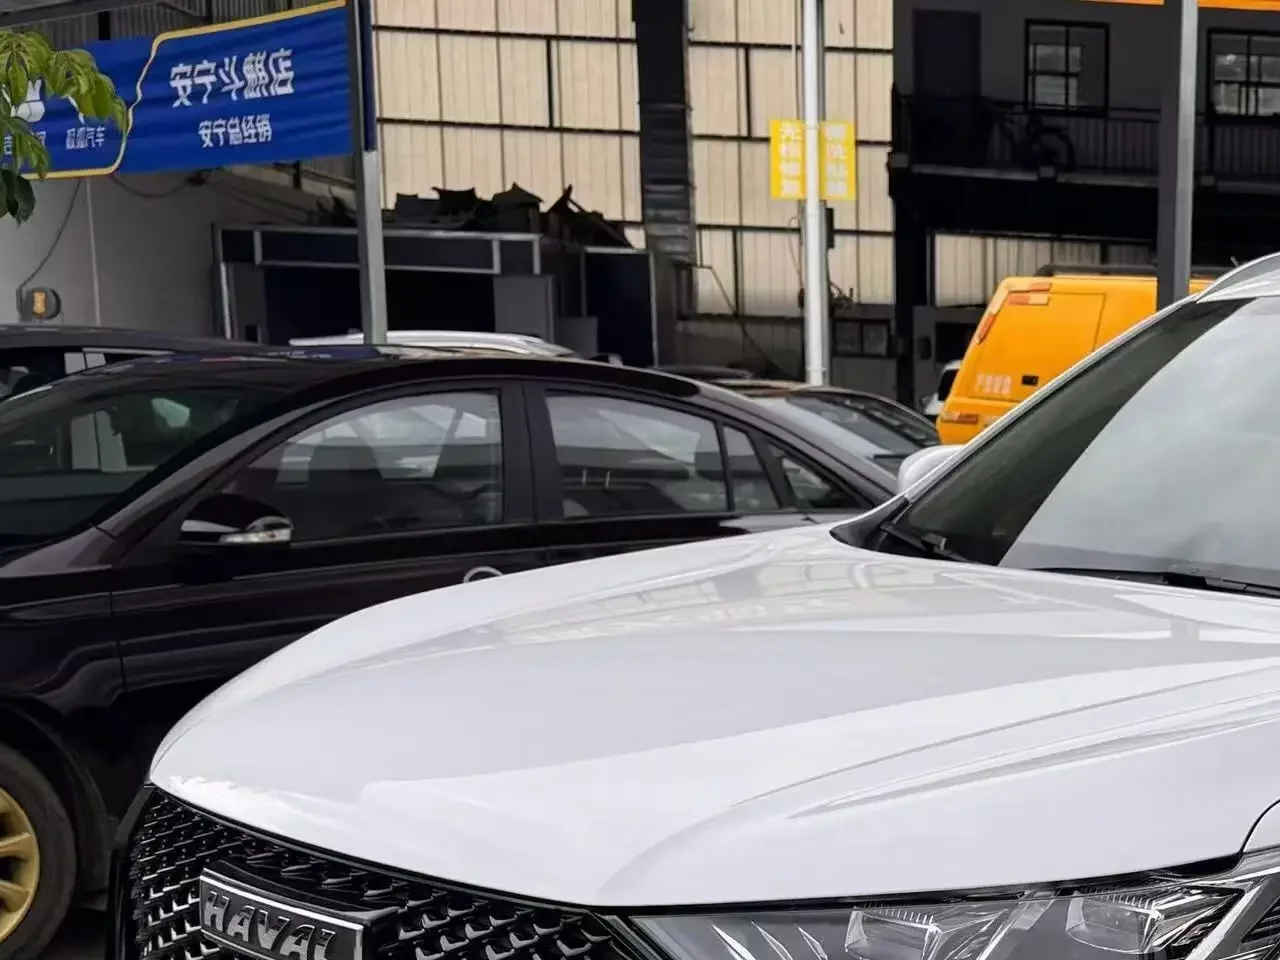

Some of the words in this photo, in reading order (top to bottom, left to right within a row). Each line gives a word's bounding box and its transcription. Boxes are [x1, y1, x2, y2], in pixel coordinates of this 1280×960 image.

[198, 113, 273, 148] 安宁总经销
